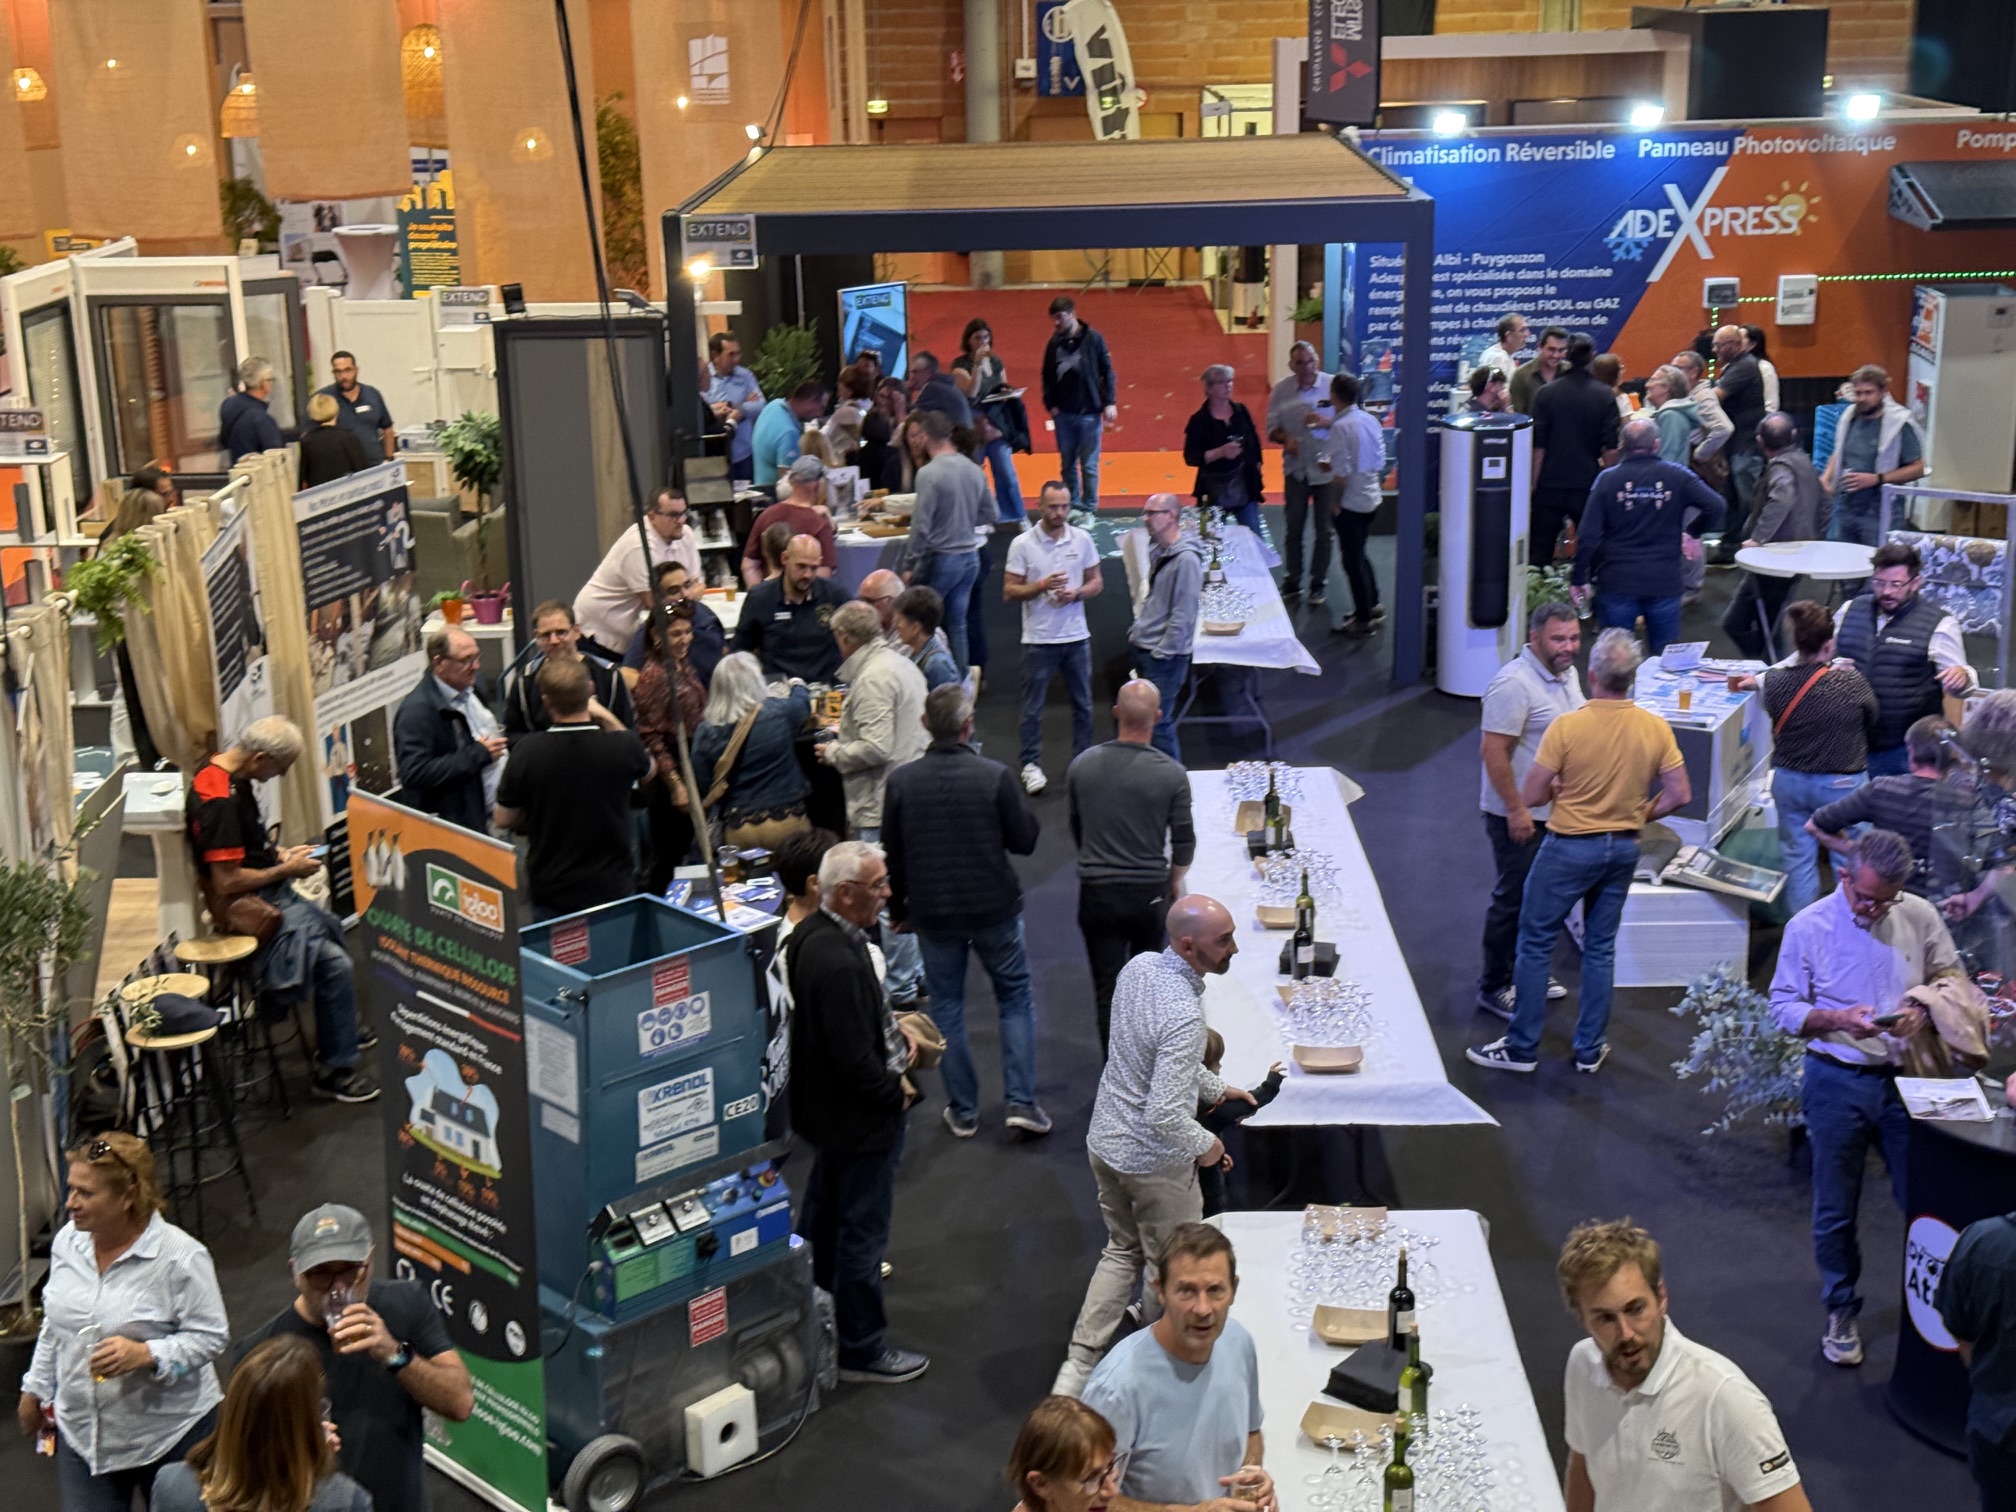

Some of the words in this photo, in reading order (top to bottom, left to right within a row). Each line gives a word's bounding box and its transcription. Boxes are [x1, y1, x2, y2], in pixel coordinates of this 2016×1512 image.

[1638, 138, 1728, 158] Panneau
[1733, 132, 1897, 156] Photovoltaïque
[1956, 129, 2016, 152] Pomp
[1367, 143, 1501, 166] Climatisation
[1505, 140, 1616, 162] Réversible
[688, 222, 749, 237] EXTEND
[1369, 254, 1406, 269] Situé
[1432, 254, 1463, 268] Albi
[1471, 253, 1545, 267] Puygouzon
[1432, 272, 1450, 282] est
[1451, 268, 1515, 284] spécialisée
[1516, 269, 1545, 280] dans
[1546, 267, 1558, 279] le
[1559, 267, 1614, 279] domaine
[442, 291, 488, 302] EXTEND
[1446, 288, 1461, 298] on
[1462, 287, 1491, 297] vous
[1493, 286, 1544, 299] propose
[1545, 284, 1557, 295] le
[1454, 301, 1471, 313] de
[1472, 299, 1536, 312] chaudières
[1537, 299, 1575, 311] FIOUL
[1576, 301, 1592, 310] ou
[1593, 297, 1620, 309] GAZ
[1368, 321, 1389, 334] par
[1591, 314, 1608, 325] de
